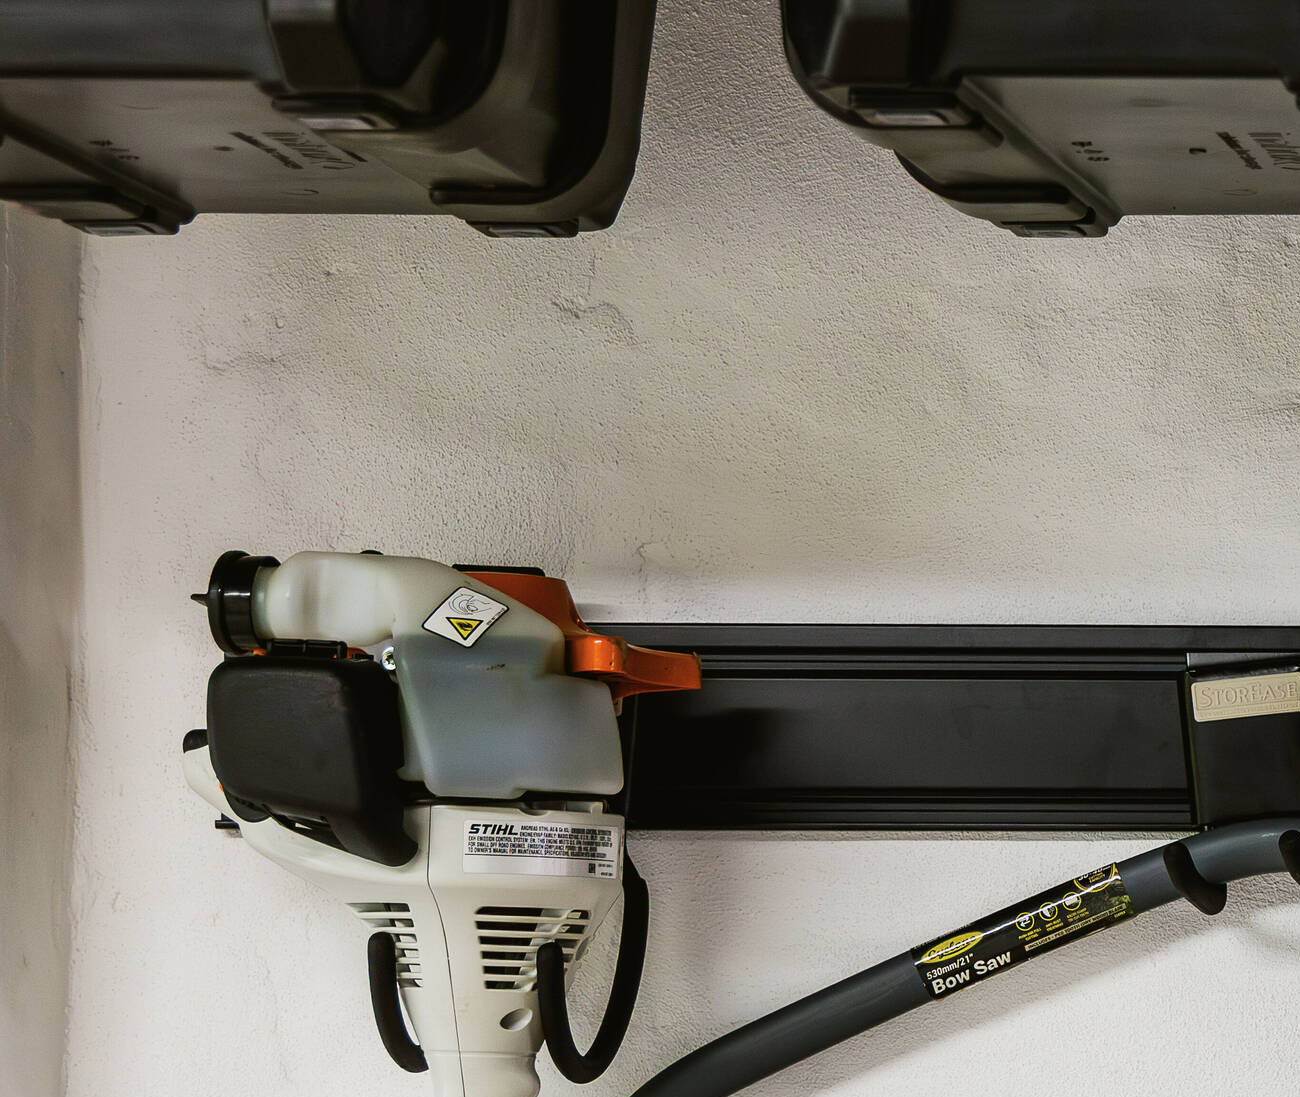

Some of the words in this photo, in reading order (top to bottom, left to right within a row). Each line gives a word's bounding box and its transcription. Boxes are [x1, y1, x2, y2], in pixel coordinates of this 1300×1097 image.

[468, 823, 518, 836] STIHL
[931, 969, 970, 994] Bow
[973, 951, 1011, 975] Saw
